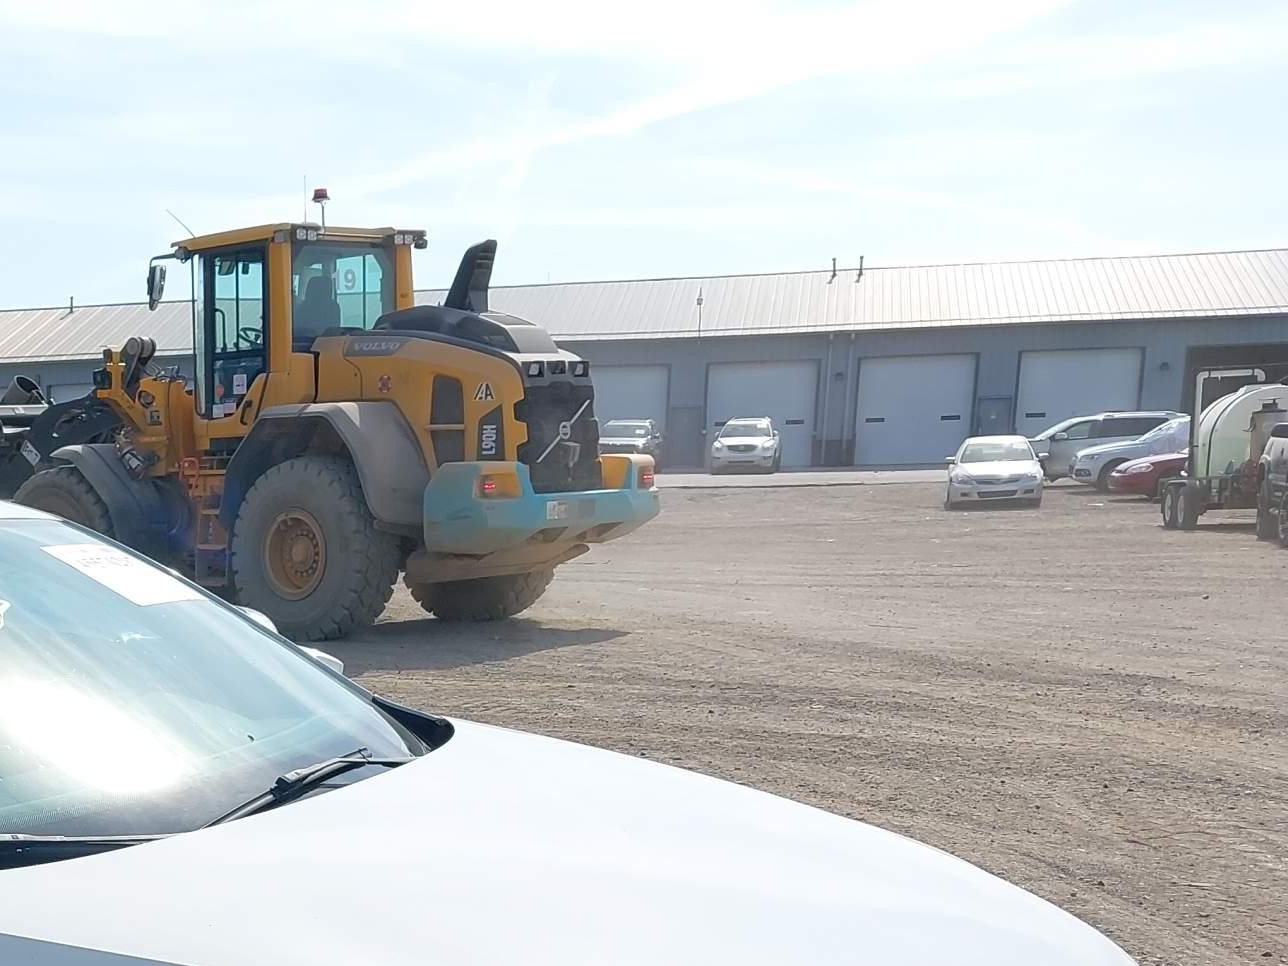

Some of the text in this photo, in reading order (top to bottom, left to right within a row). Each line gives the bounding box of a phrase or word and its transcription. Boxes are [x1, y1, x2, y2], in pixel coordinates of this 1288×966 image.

[344, 268, 356, 291] 9
[353, 342, 401, 351] VOLVO
[481, 424, 497, 455] L90H
